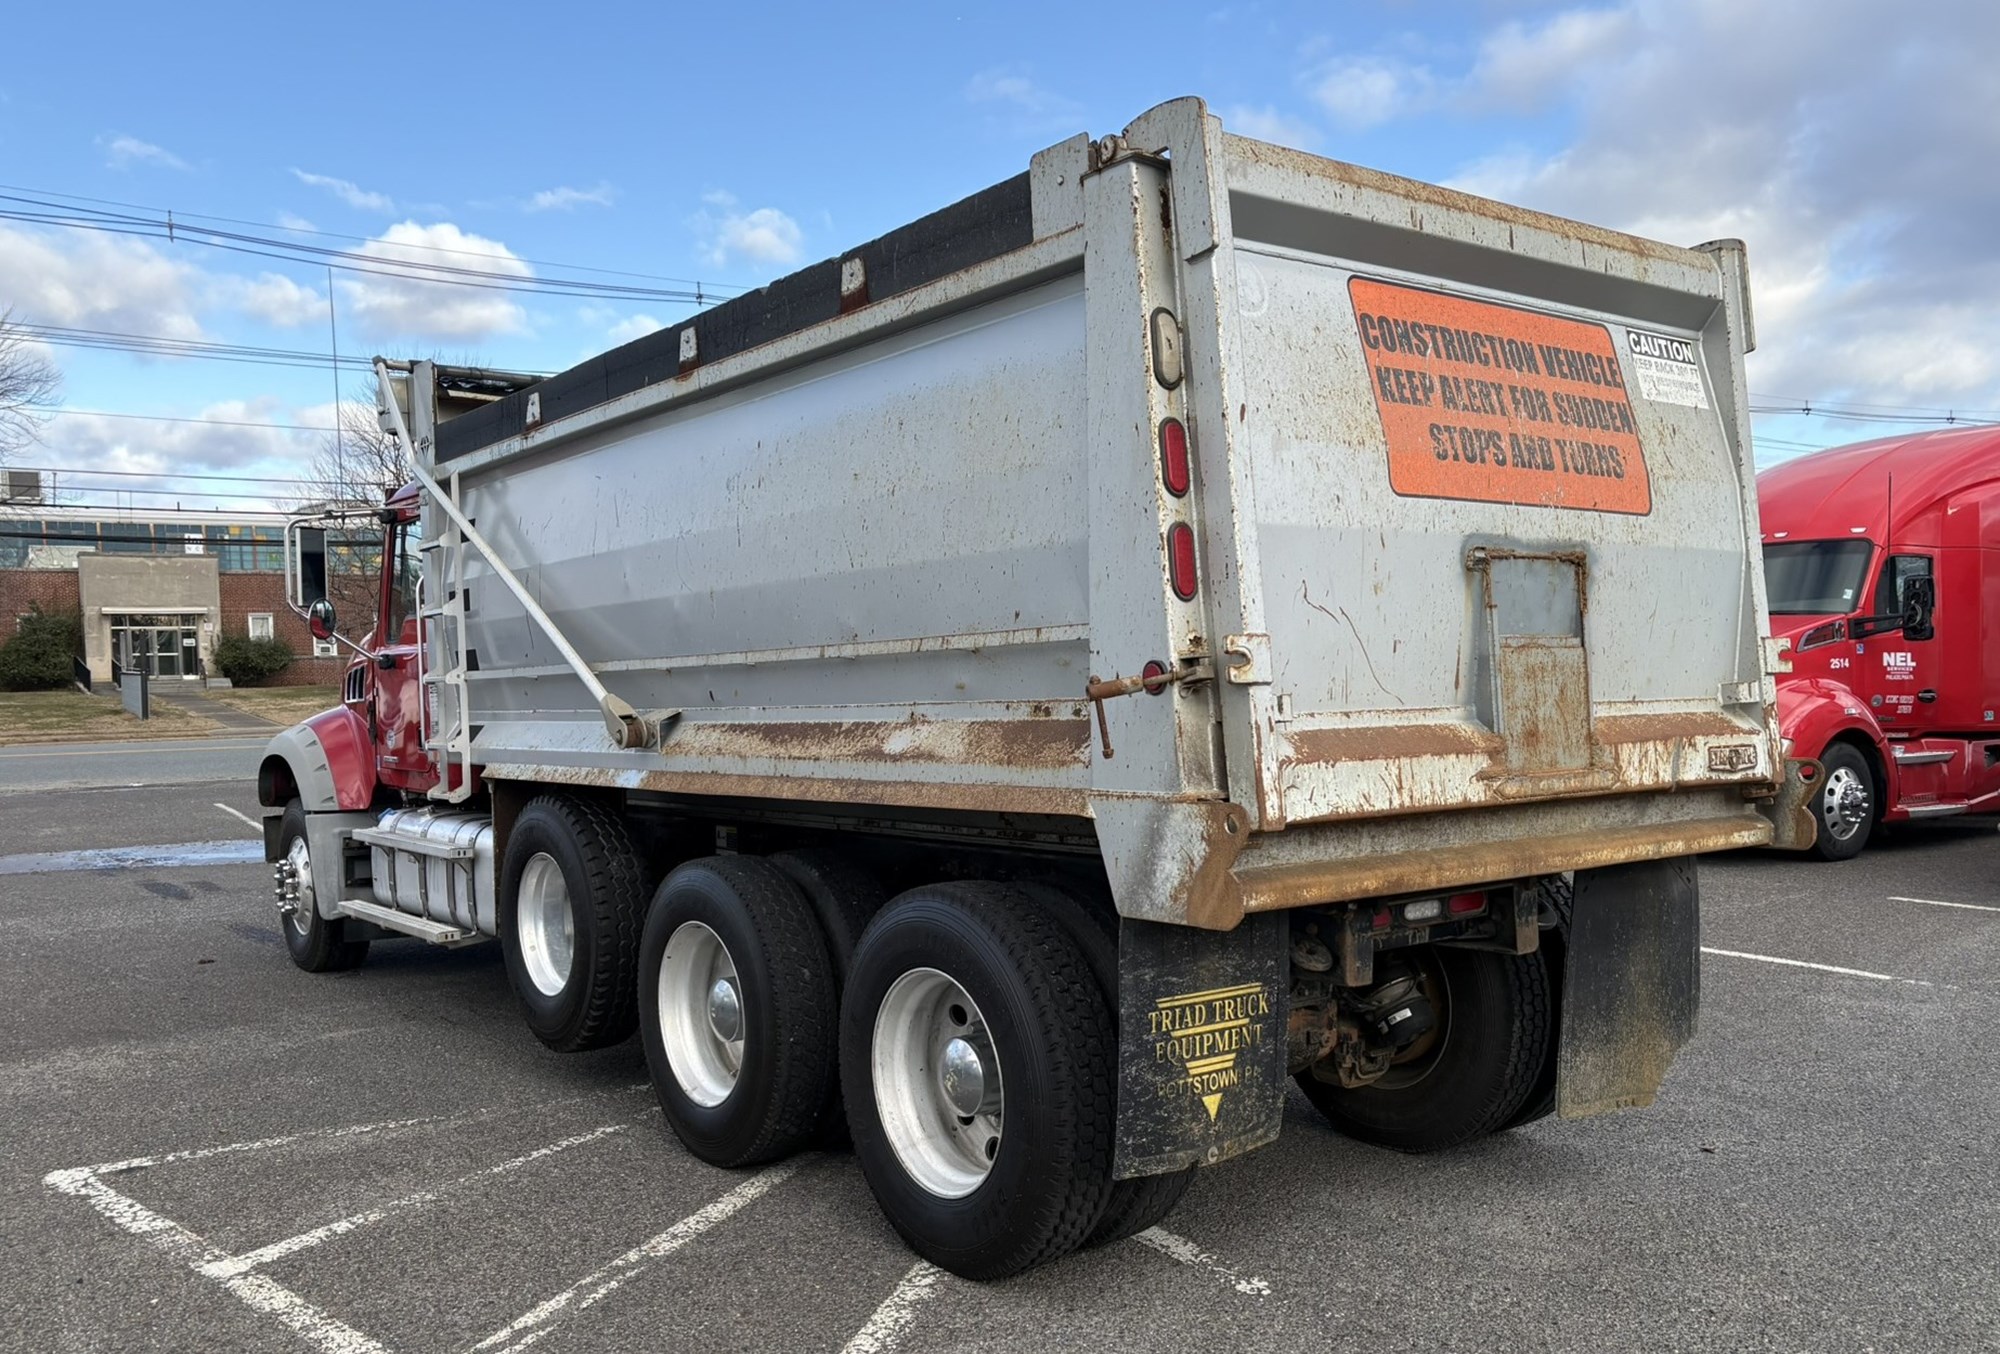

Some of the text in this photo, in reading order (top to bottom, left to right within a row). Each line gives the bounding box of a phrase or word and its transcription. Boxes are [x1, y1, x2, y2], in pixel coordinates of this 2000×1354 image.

[1359, 312, 1622, 389] CONSTRUCTION VEHICLE
[1629, 332, 1695, 363] CAUTION
[1376, 366, 1633, 434] KEEP ALERT FOR SUDDEN
[1429, 422, 1625, 480] STOPS AND TURNS
[1830, 658, 1849, 669] 2514
[1883, 652, 1916, 667] NEL
[1148, 993, 1269, 1033] TRIAD TRUCK
[1156, 1024, 1263, 1066] EQUIPMENT
